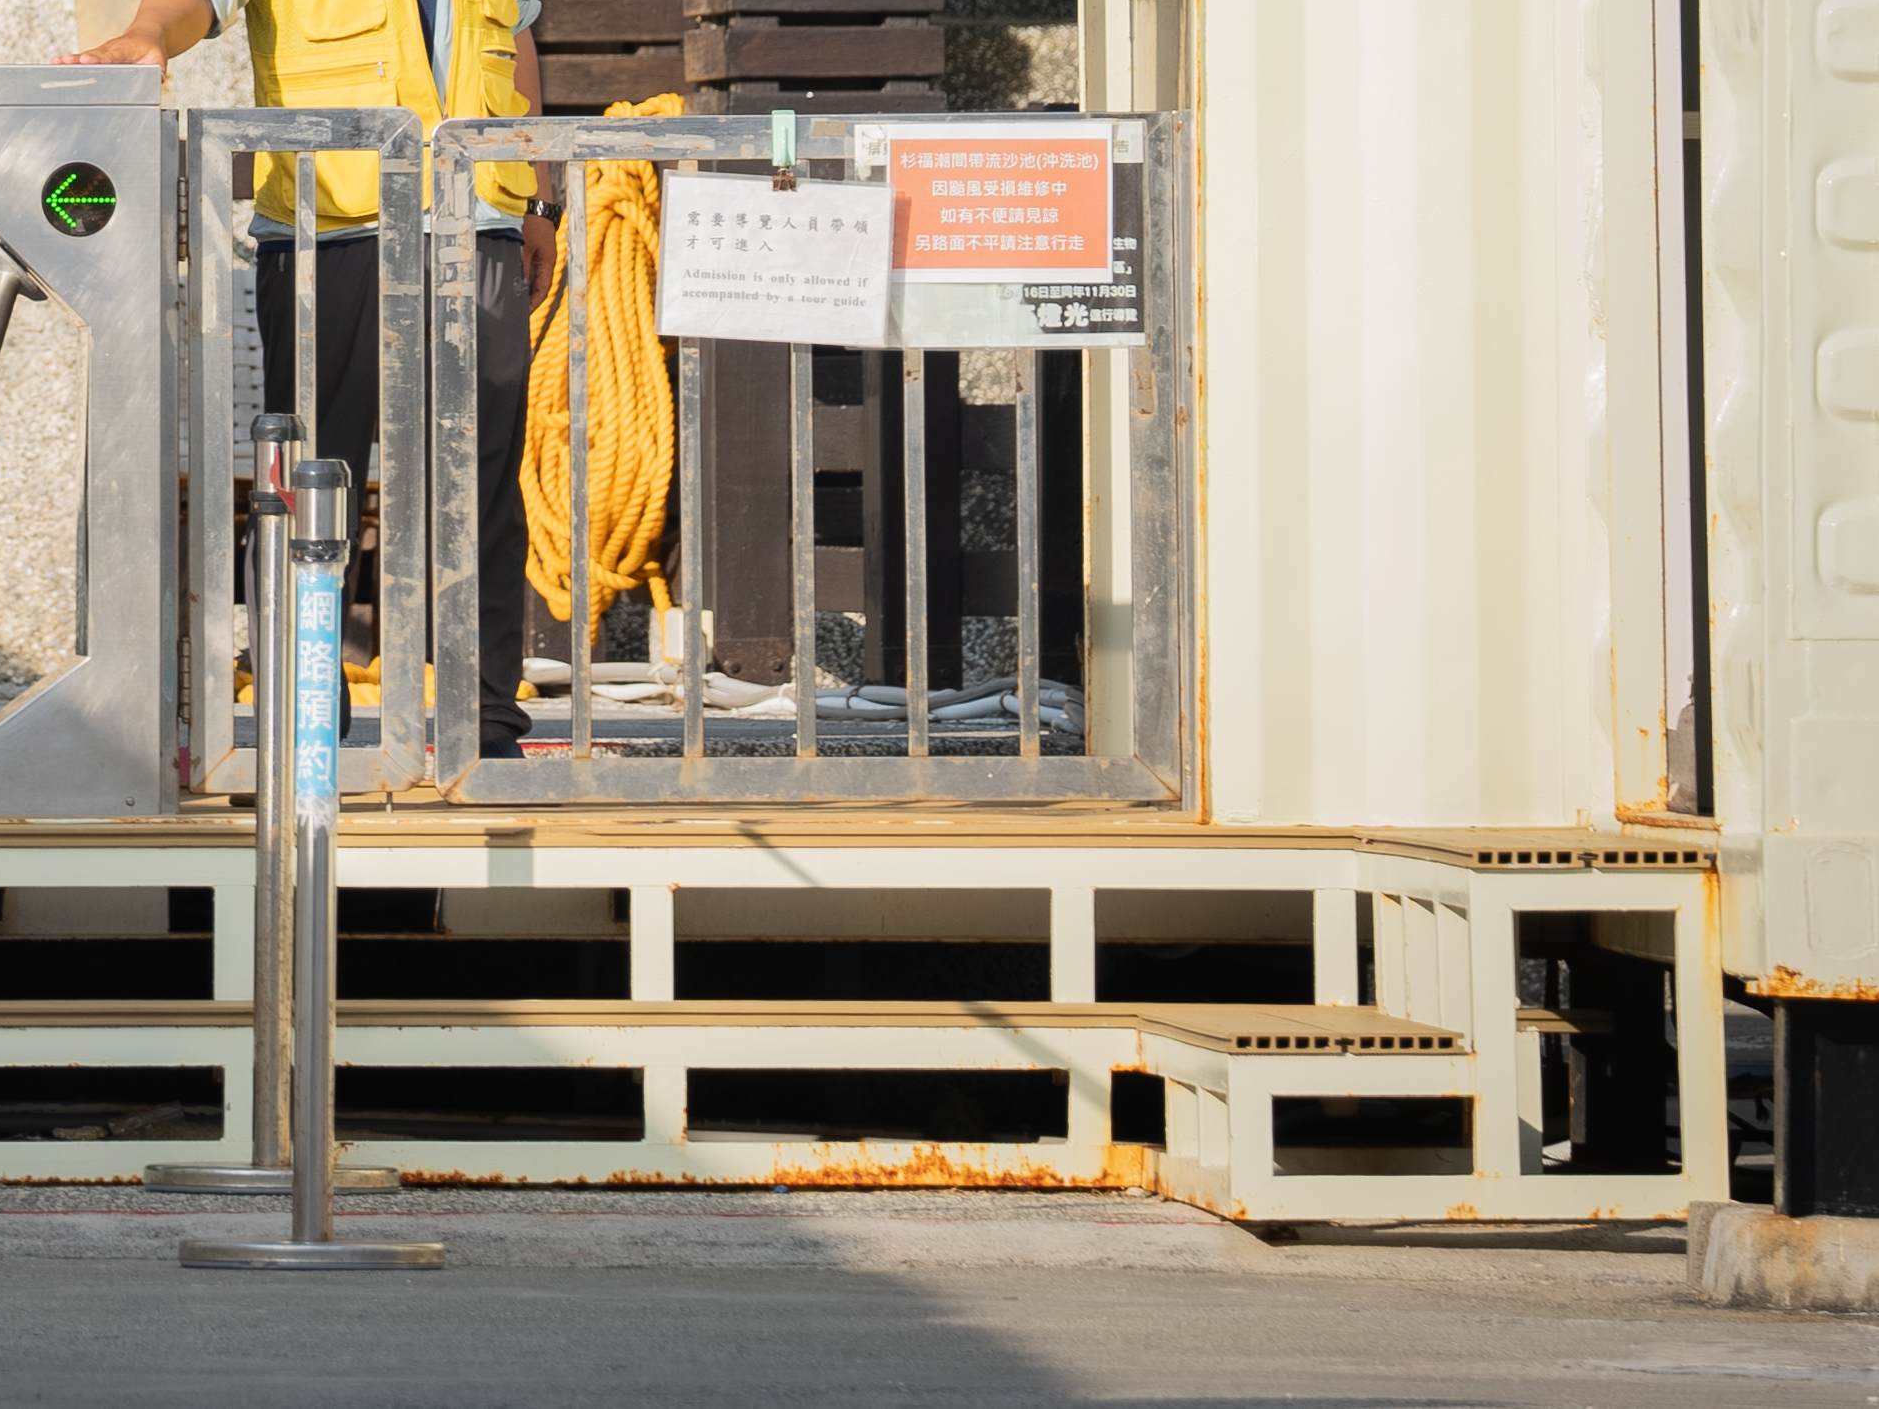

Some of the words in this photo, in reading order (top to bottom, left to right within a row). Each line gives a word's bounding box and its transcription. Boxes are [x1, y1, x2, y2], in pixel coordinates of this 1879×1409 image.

[900, 152, 1099, 170] 杉福潮間帶流沙池(沖洗池)
[931, 179, 1068, 197] 因颱風受損維修中
[687, 211, 869, 234] 需要導覽人員帶領
[940, 207, 1059, 224] 如有不便請見諒
[686, 234, 774, 252] 才可進入
[914, 235, 1085, 251] 另路面不平請注意行走
[683, 269, 746, 281] Admission
[753, 271, 763, 282] is
[770, 273, 796, 286] only
[803, 275, 850, 287] allowed
[857, 277, 869, 288] if
[682, 289, 759, 301] accompanied
[766, 292, 781, 304] by
[801, 294, 827, 304] tour
[833, 296, 867, 307] guide
[299, 591, 335, 780] 網路預約
